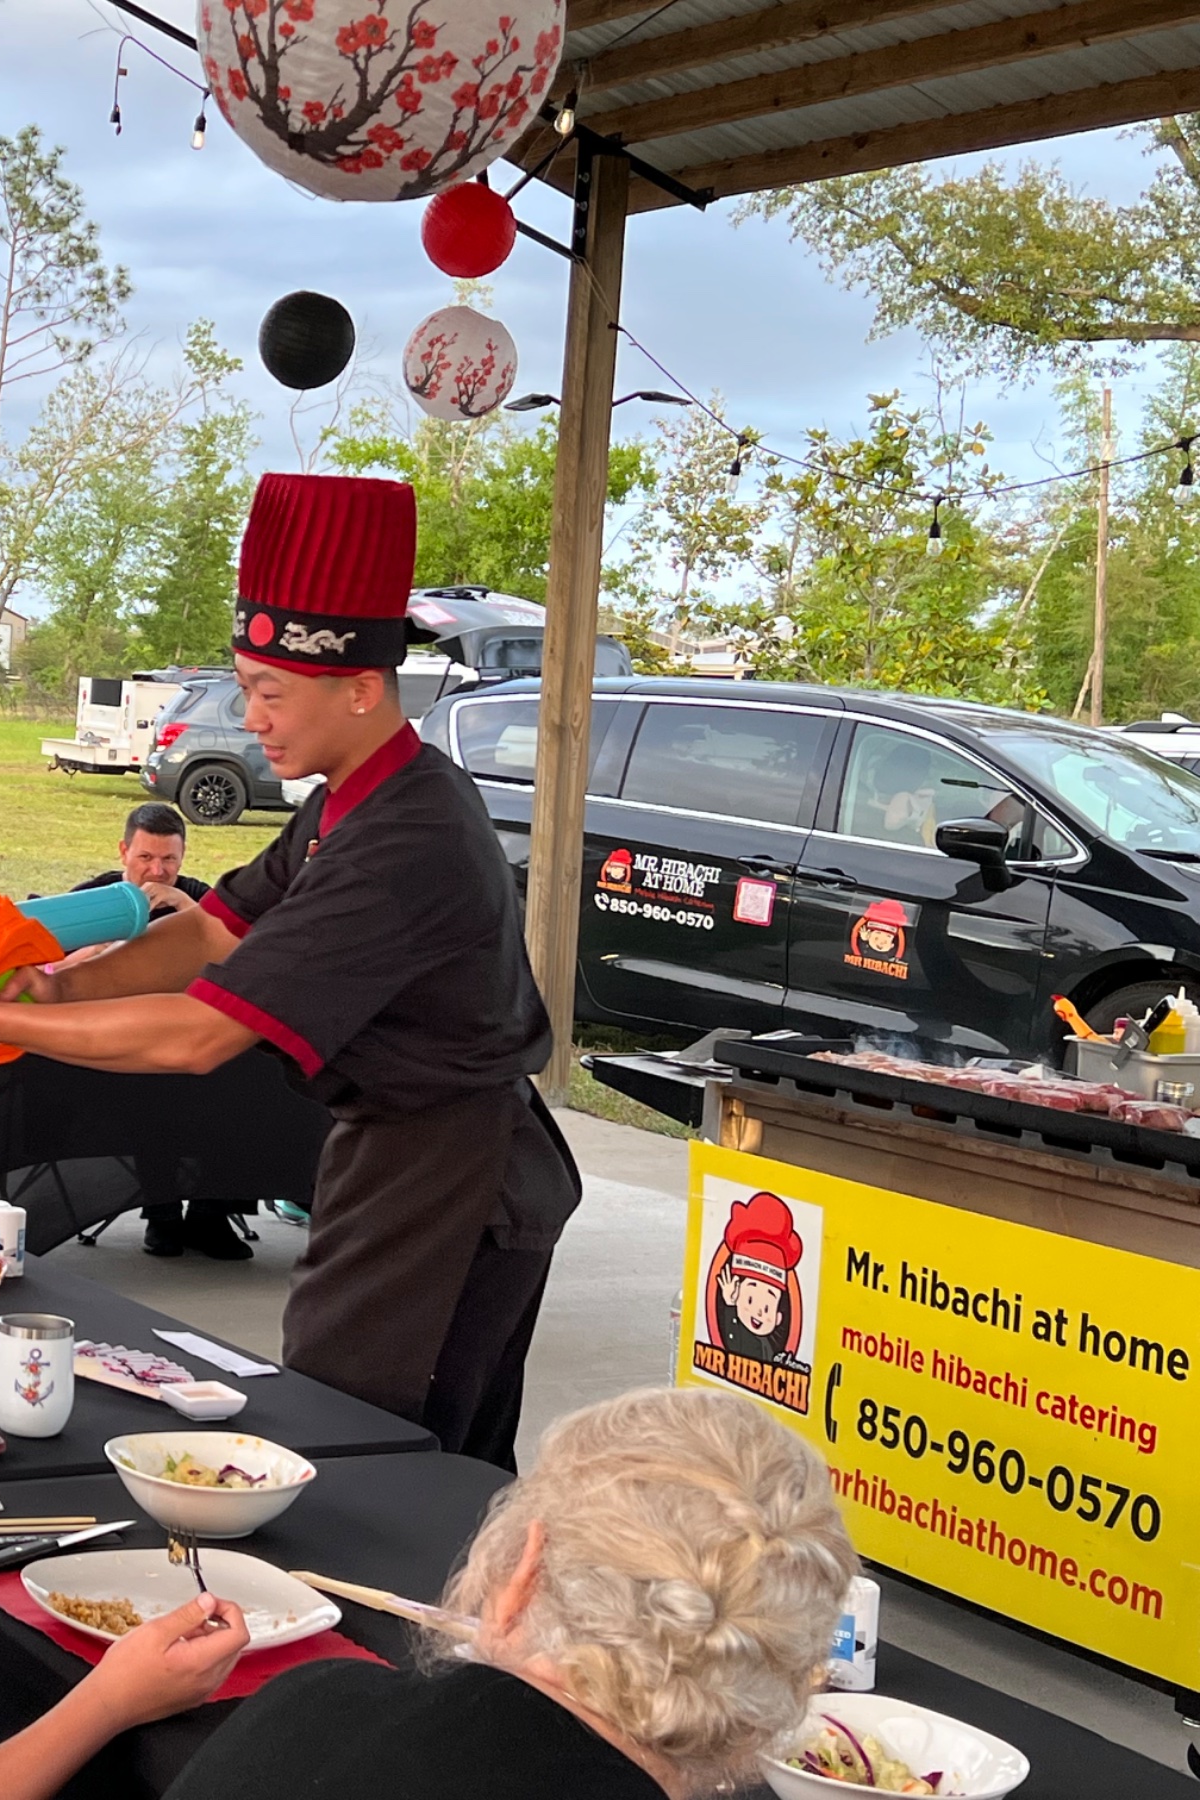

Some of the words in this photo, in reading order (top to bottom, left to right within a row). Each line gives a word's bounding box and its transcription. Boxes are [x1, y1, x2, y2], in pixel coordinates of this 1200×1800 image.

[642, 872, 662, 889] AT
[662, 875, 705, 897] HOME
[660, 858, 722, 884] HIBACHI
[609, 897, 714, 931] 850-960-0570
[843, 953, 863, 968] MR
[862, 957, 909, 980] HIBACHI
[845, 1246, 889, 1294] Mr.
[899, 1261, 1023, 1333] hibachi
[1031, 1308, 1068, 1347] at
[1079, 1312, 1190, 1382] home
[695, 1343, 725, 1376] MR
[726, 1353, 810, 1413] HIBACHI
[841, 1326, 925, 1374] mobile
[931, 1349, 1028, 1408] hibachi
[1035, 1389, 1158, 1455] catering
[856, 1398, 1162, 1542] 850-960-0570
